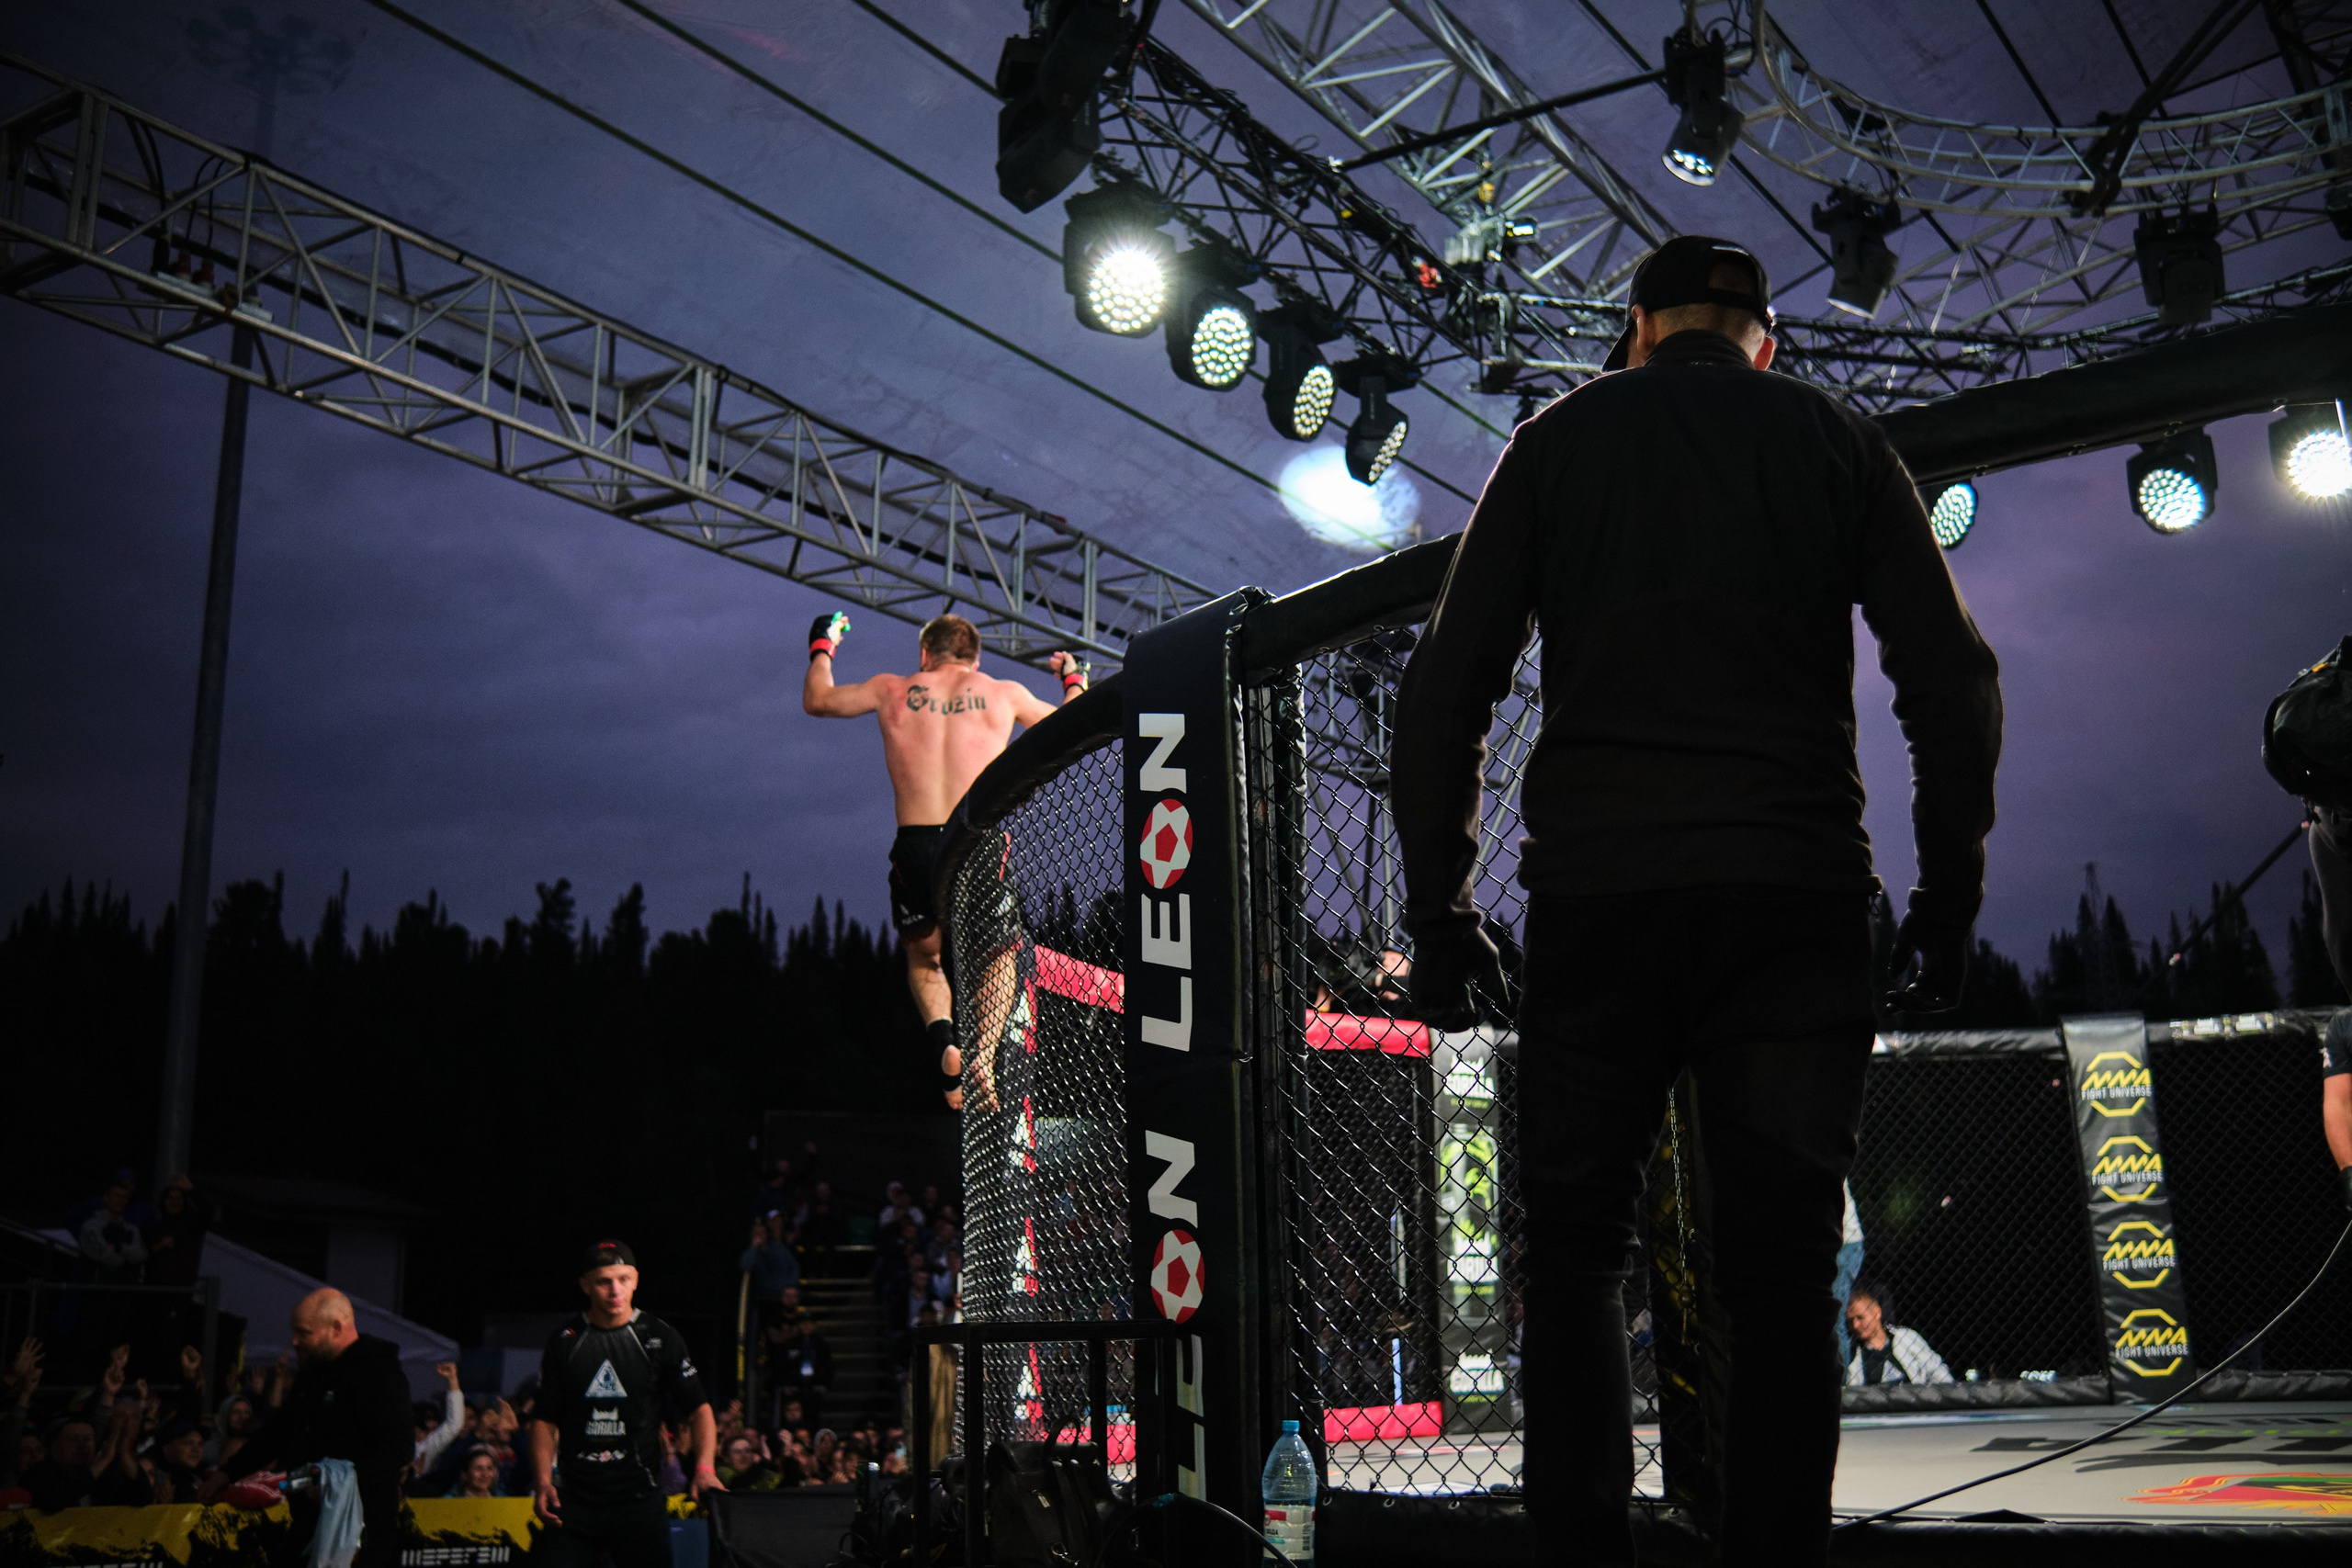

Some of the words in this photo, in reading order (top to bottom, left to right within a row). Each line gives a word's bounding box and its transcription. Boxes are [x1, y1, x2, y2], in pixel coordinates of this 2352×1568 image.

[1138, 712, 1193, 1052] LEON
[2081, 1068, 2152, 1090] MMA
[2081, 1087, 2108, 1100] FIGHT
[2109, 1084, 2152, 1098] UNIVERSE
[2091, 1153, 2163, 1175] MMA
[2091, 1171, 2118, 1186] FIGHT
[2120, 1169, 2164, 1183] UNIVERSE
[2102, 1238, 2175, 1261] MMA
[2102, 1258, 2130, 1271] FIGHT
[2132, 1255, 2177, 1269] UNIVERSE
[2114, 1325, 2188, 1348] MMA
[2115, 1345, 2142, 1359] FIGHT
[2143, 1343, 2189, 1358] UNIVERSE
